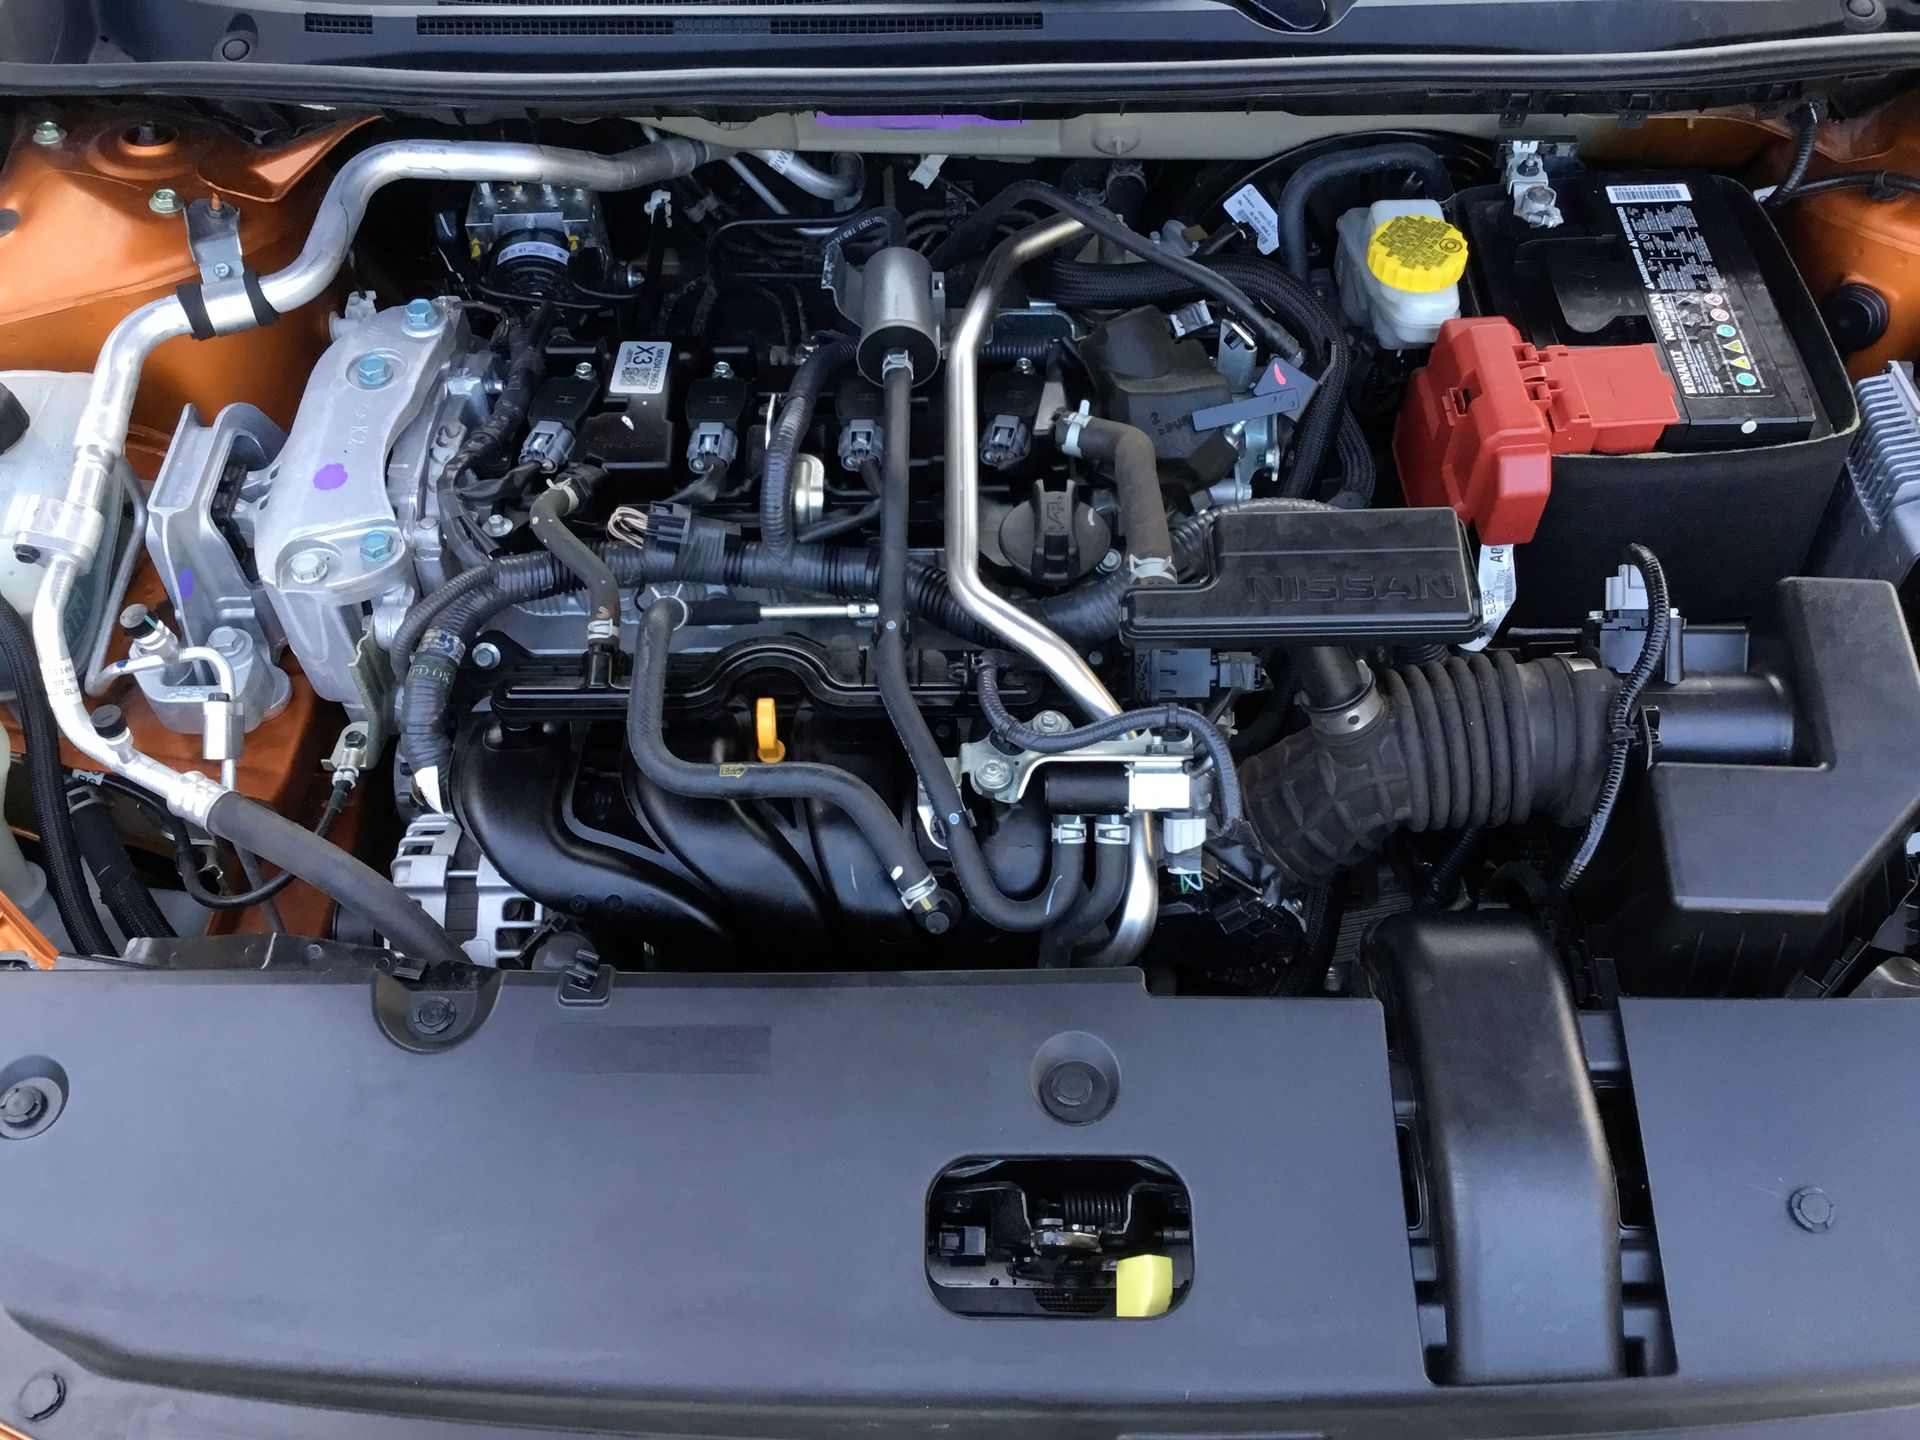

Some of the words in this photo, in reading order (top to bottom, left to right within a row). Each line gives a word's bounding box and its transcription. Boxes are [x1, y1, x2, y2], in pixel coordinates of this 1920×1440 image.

[1649, 293, 1677, 341] NISSAN
[633, 345, 656, 365] X3
[1669, 349, 1698, 394] RENAULT
[1246, 572, 1457, 602] NISSAN
